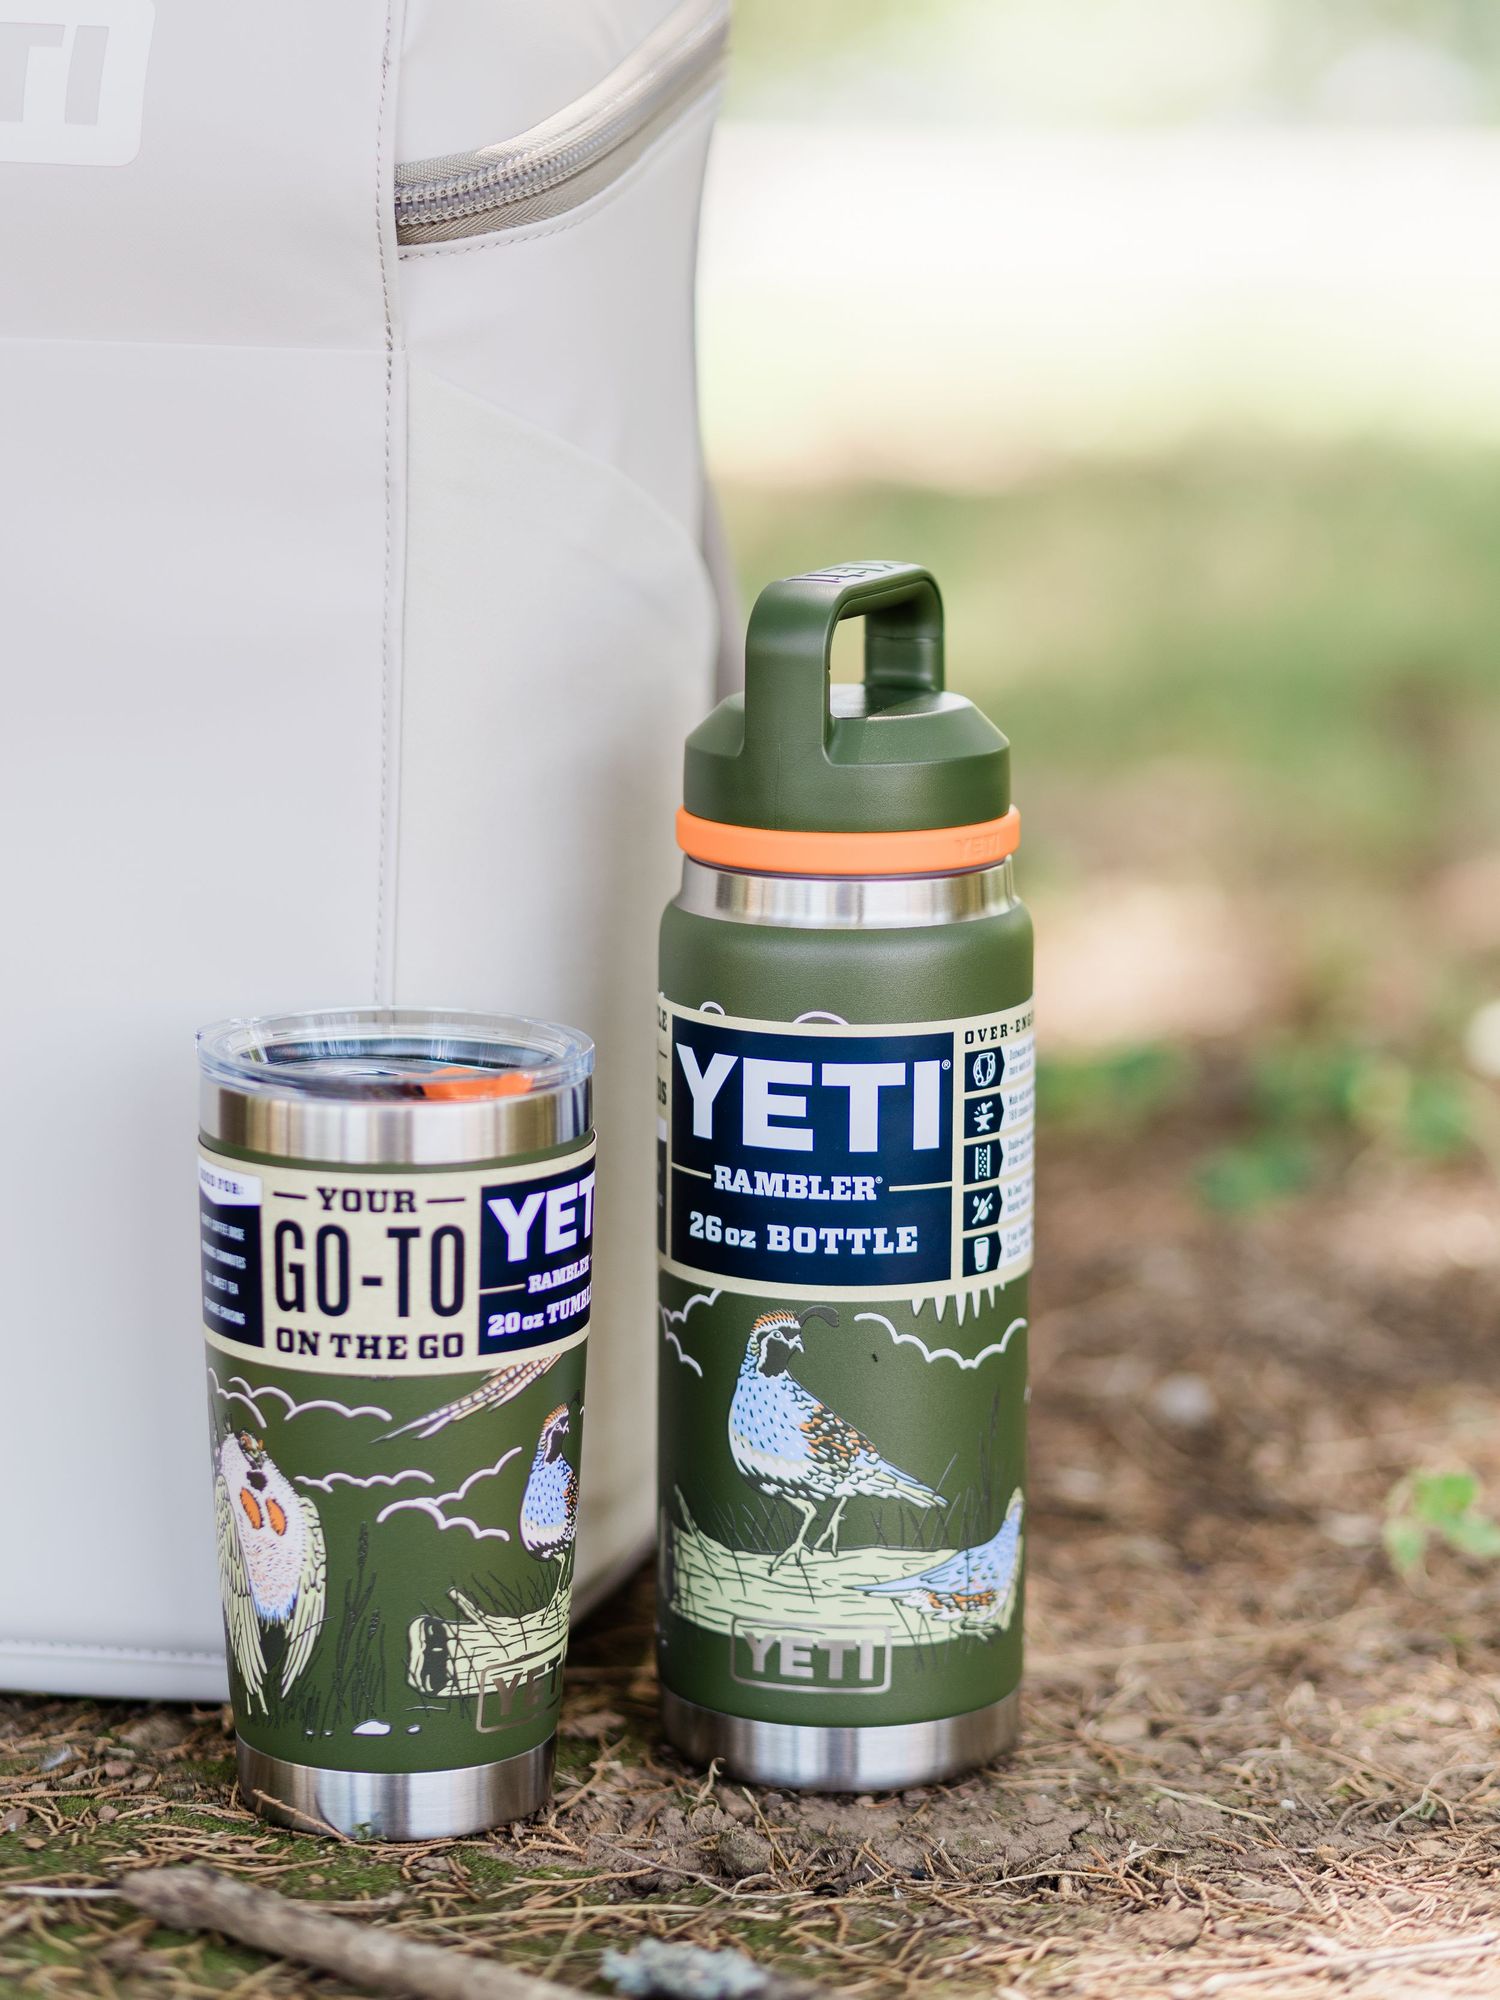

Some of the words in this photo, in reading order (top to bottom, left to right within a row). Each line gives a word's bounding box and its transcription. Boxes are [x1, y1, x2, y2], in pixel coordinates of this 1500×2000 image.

[317, 1187, 417, 1213] YOUR
[689, 1211, 756, 1249] 26oz
[767, 1224, 918, 1255] BOTTLE
[274, 1219, 465, 1318] GO-TO
[487, 1311, 545, 1337] 20oz
[276, 1327, 320, 1356] ON
[330, 1333, 408, 1360] THE
[418, 1332, 465, 1359] GO
[743, 1631, 874, 1681] YETI
